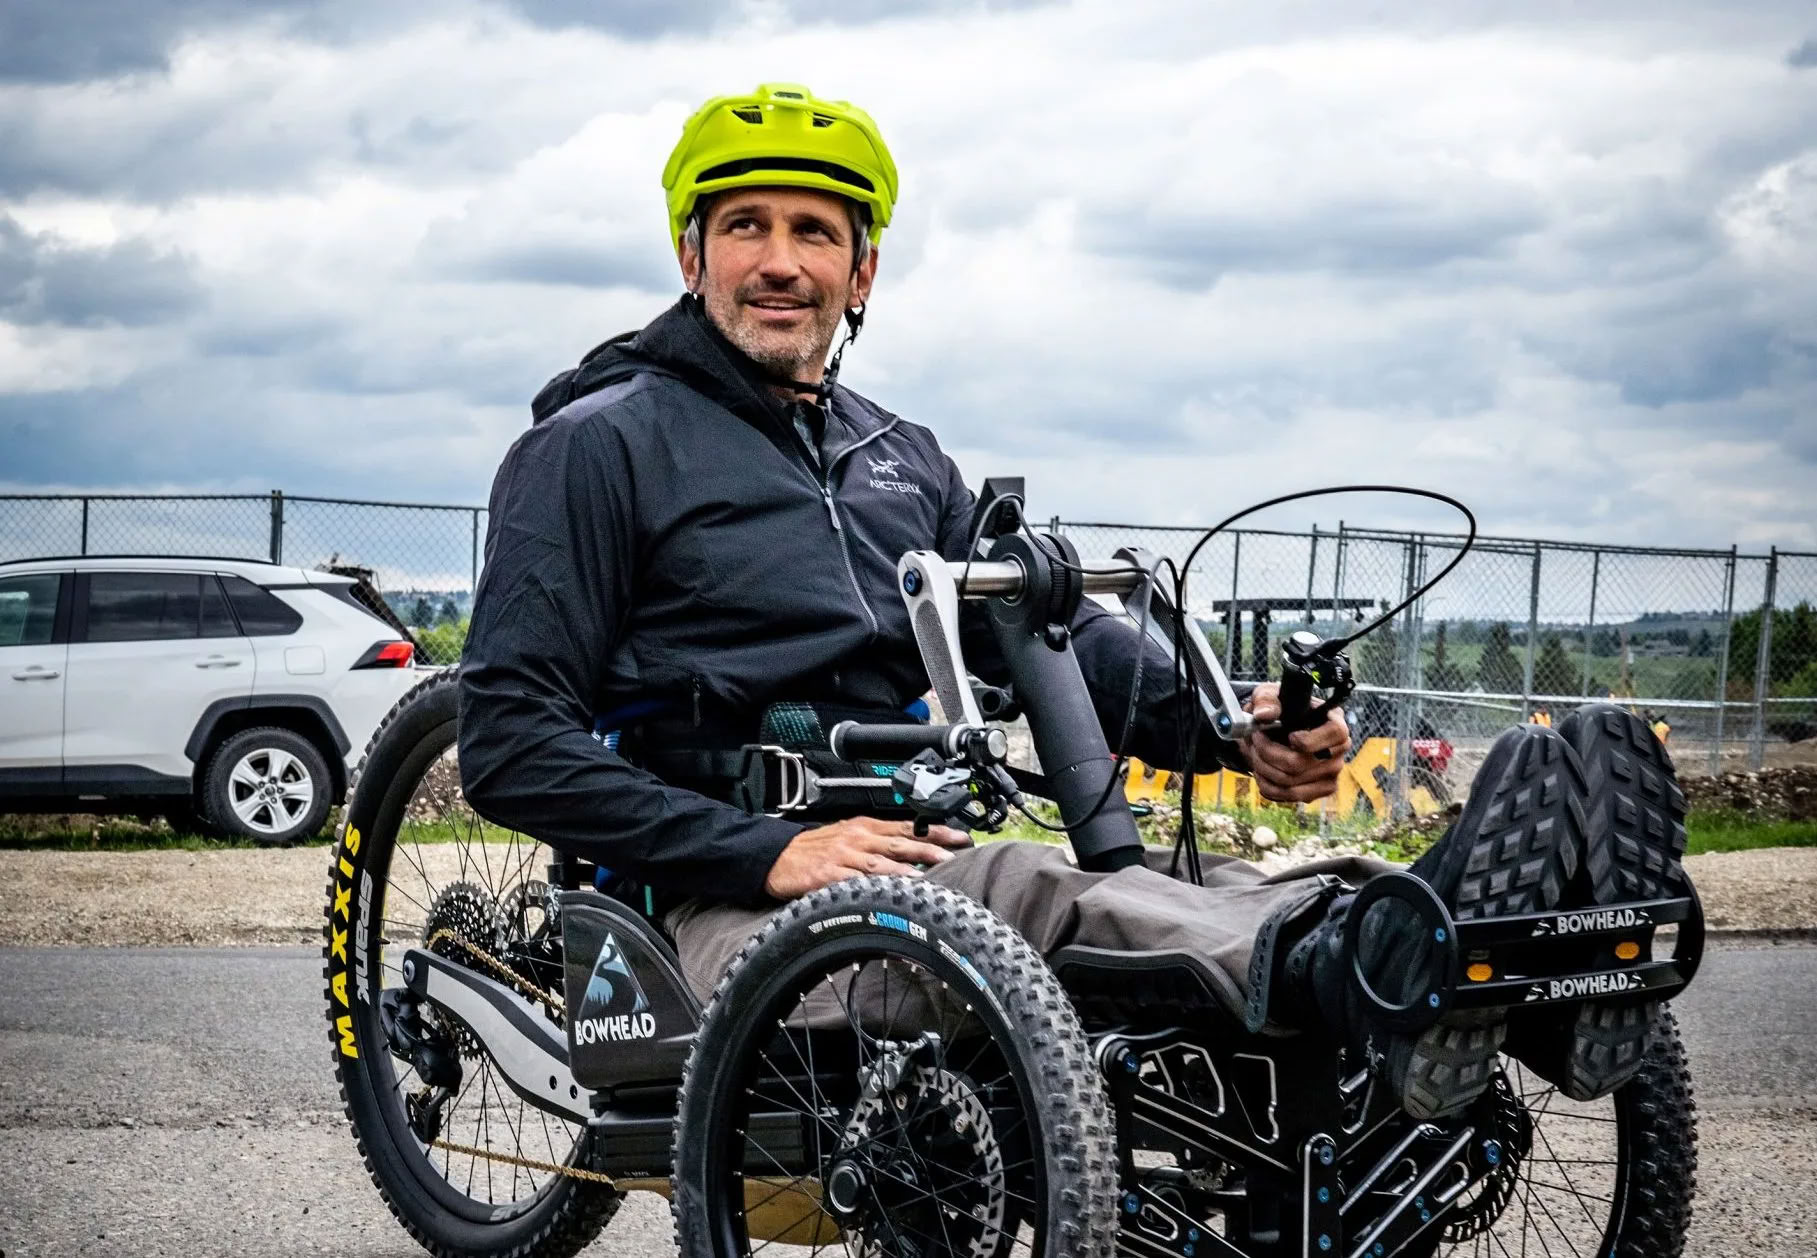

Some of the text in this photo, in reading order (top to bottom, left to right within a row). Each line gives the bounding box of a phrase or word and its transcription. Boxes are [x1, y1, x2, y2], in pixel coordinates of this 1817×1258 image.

[909, 921, 928, 942] GEM
[1557, 909, 1636, 935] BOWHEAD
[331, 822, 360, 1059] MAXXIS
[1550, 973, 1629, 999] BOWHEAD
[574, 1012, 657, 1046] BOWHEAD
